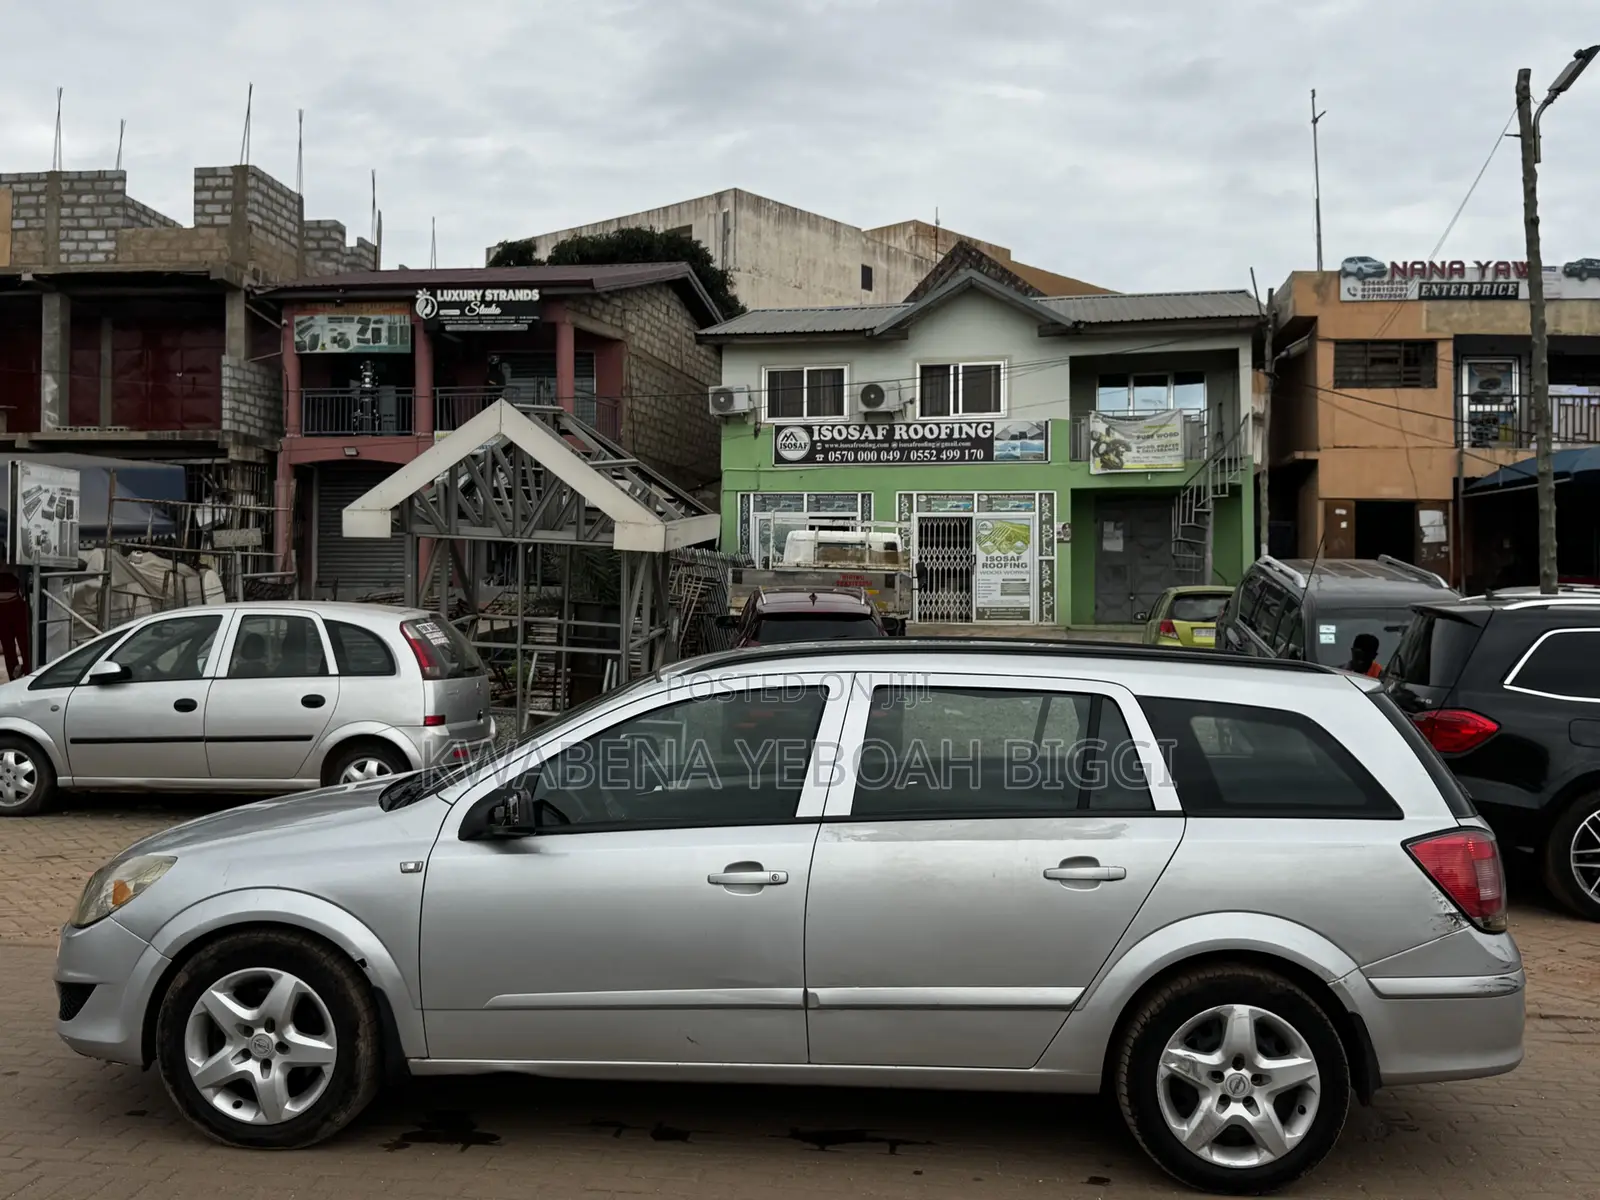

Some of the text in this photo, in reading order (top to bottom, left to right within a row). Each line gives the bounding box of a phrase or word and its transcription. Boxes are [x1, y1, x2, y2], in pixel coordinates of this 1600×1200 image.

[1390, 260, 1465, 279] NANA
[437, 289, 540, 301] LUXURY STRANDS
[465, 302, 501, 316] Studio
[812, 423, 993, 440] ISOSAF ROOFING
[780, 442, 808, 450] ISOSAF
[828, 449, 984, 462] 0570 000 049 / 0552 499 170
